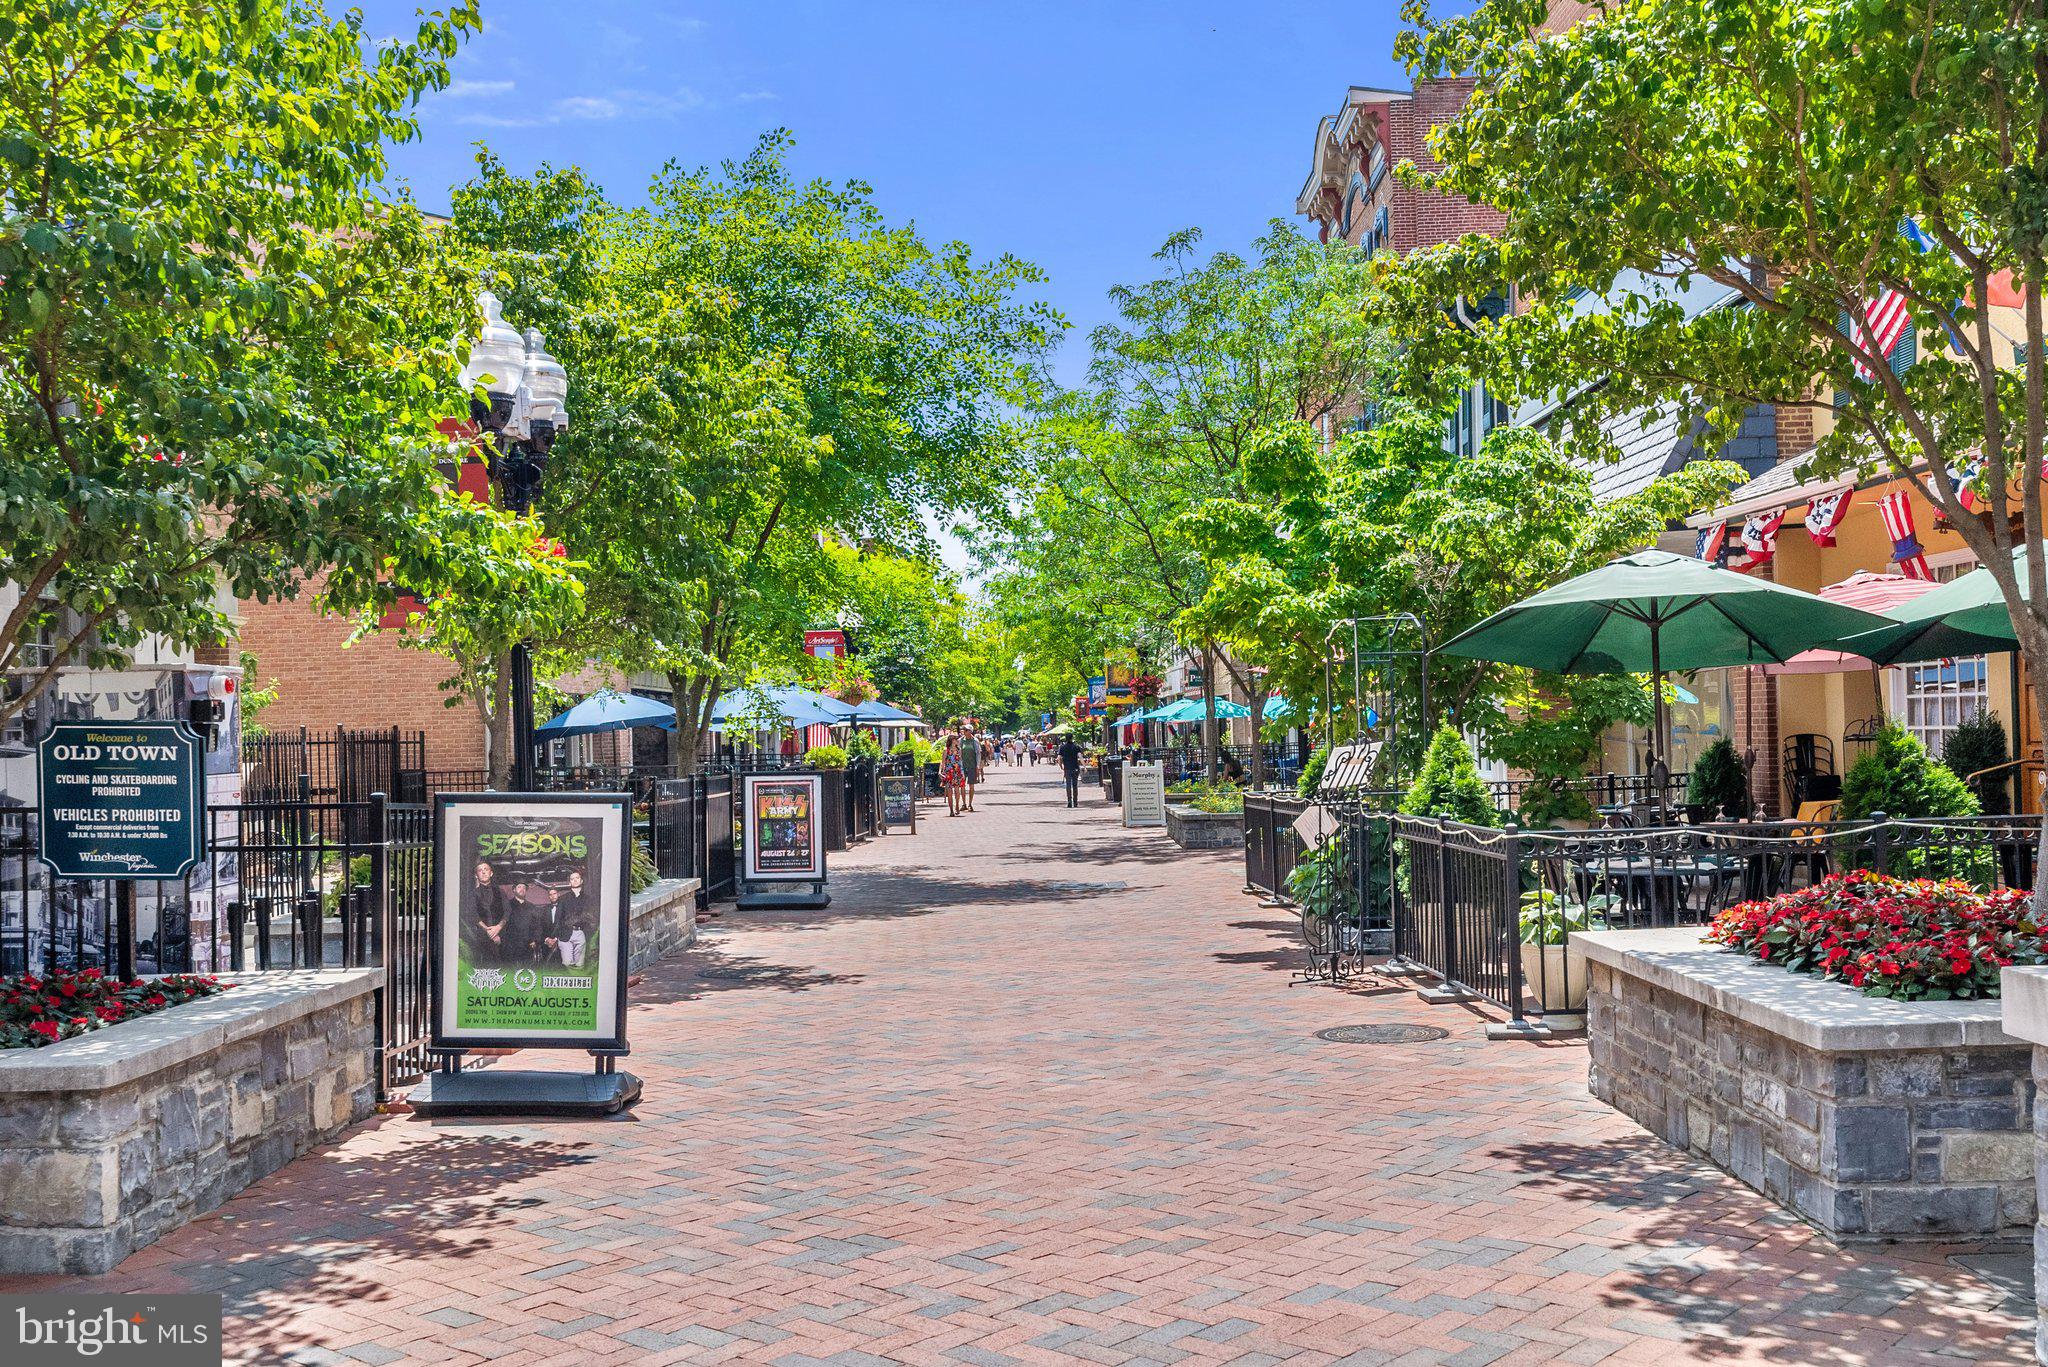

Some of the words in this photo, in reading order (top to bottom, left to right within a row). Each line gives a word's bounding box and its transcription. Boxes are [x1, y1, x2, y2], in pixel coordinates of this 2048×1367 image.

[86, 733, 133, 743] Welcome
[136, 733, 148, 742] to
[53, 745, 101, 761] OLD
[106, 745, 178, 761] TOWN
[56, 774, 90, 784] CYCLING
[92, 774, 109, 784] AND
[110, 775, 177, 785] SKATEBOARDING
[92, 787, 141, 797] PROHIBITED
[53, 808, 108, 821] VEHICLES
[111, 809, 181, 822] PROHIBITED
[769, 806, 799, 815] ARMY
[75, 823, 93, 831] Except
[477, 834, 588, 859] SEASONS
[79, 851, 142, 862] Winchester
[761, 850, 786, 858] AUGUST
